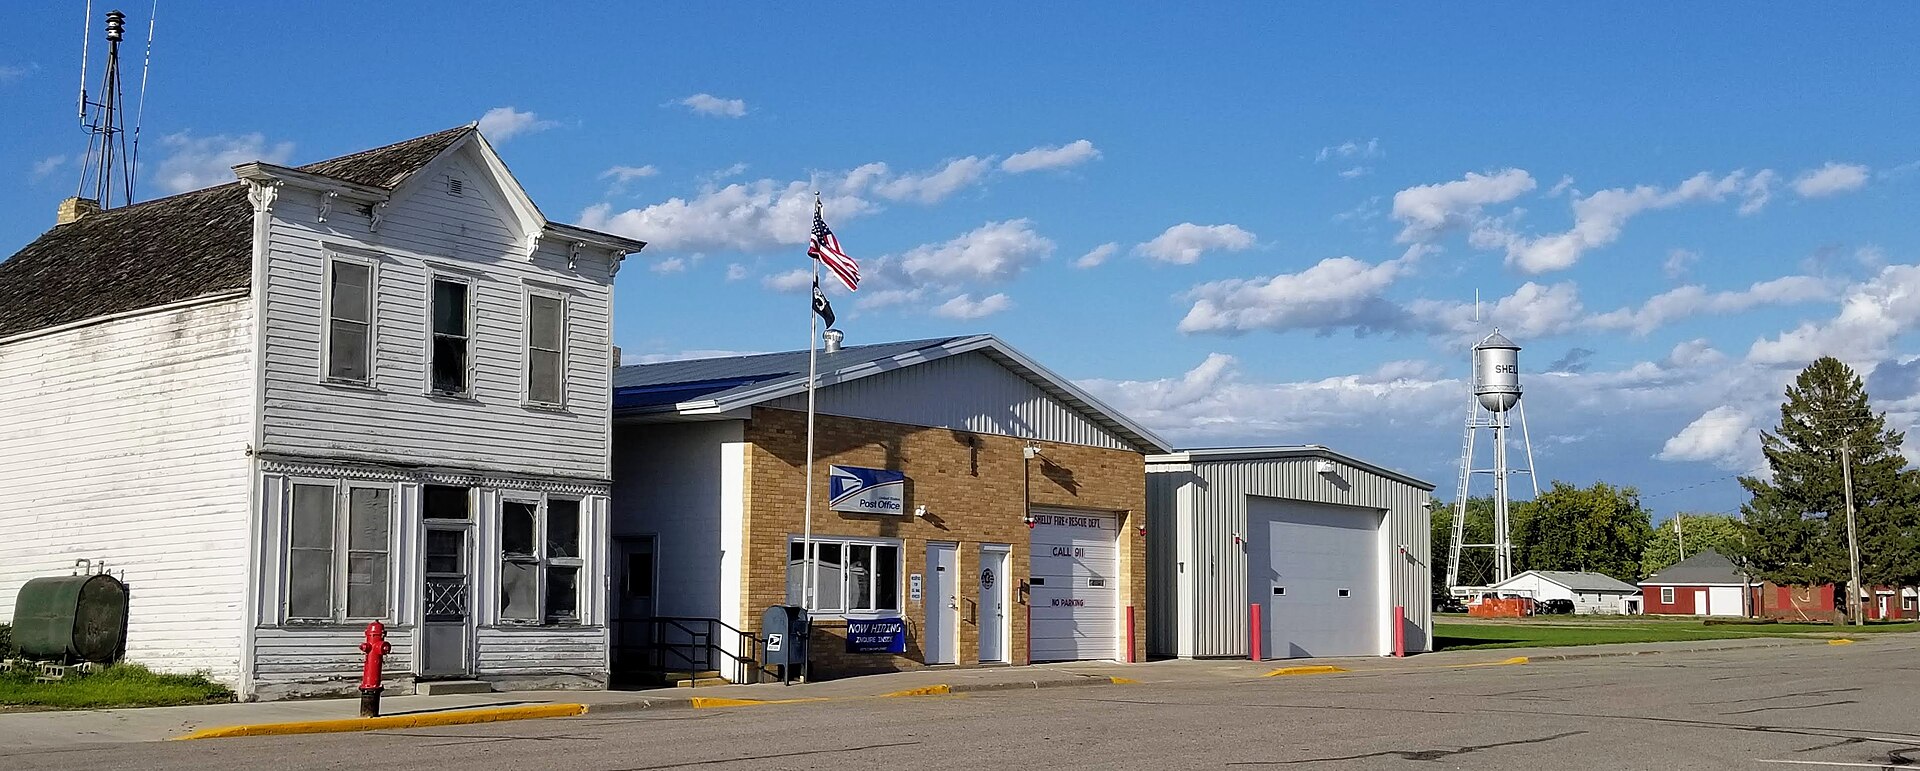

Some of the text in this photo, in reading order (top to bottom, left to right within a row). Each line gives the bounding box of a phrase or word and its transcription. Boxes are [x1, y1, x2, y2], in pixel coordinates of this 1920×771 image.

[860, 499, 901, 510] Post Office
[1053, 515, 1065, 526] FIRE
[1068, 516, 1087, 528] RESCUE
[1052, 546, 1085, 558] CALL 911
[1051, 598, 1084, 607] NO PARKING
[848, 623, 901, 634] NOW HIRING
